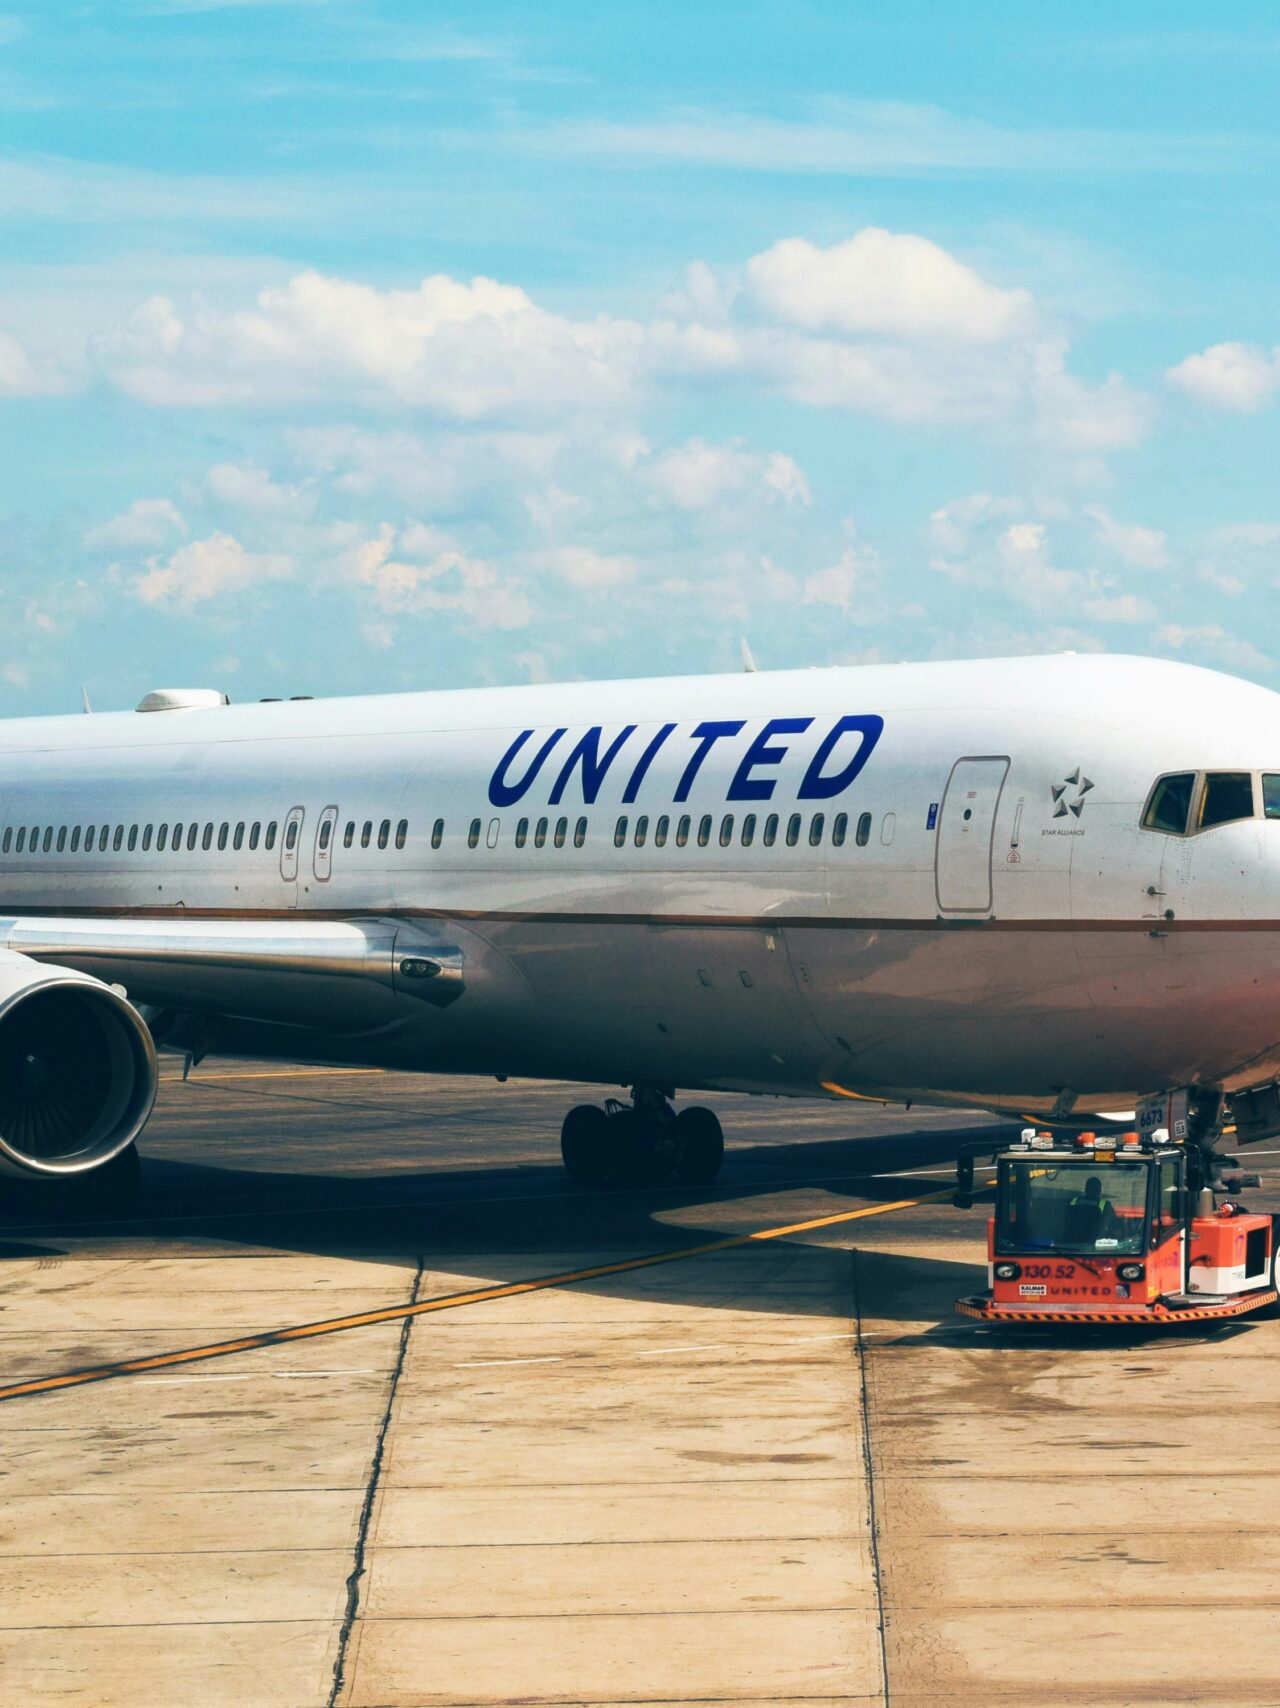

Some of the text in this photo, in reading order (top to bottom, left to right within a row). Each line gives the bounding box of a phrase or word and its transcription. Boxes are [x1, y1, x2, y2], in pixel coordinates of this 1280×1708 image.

[488, 714, 884, 807] UNITED
[1140, 1109, 1163, 1127] 6673
[1023, 1265, 1076, 1279] 130.52
[1051, 1287, 1111, 1295] UNITED
